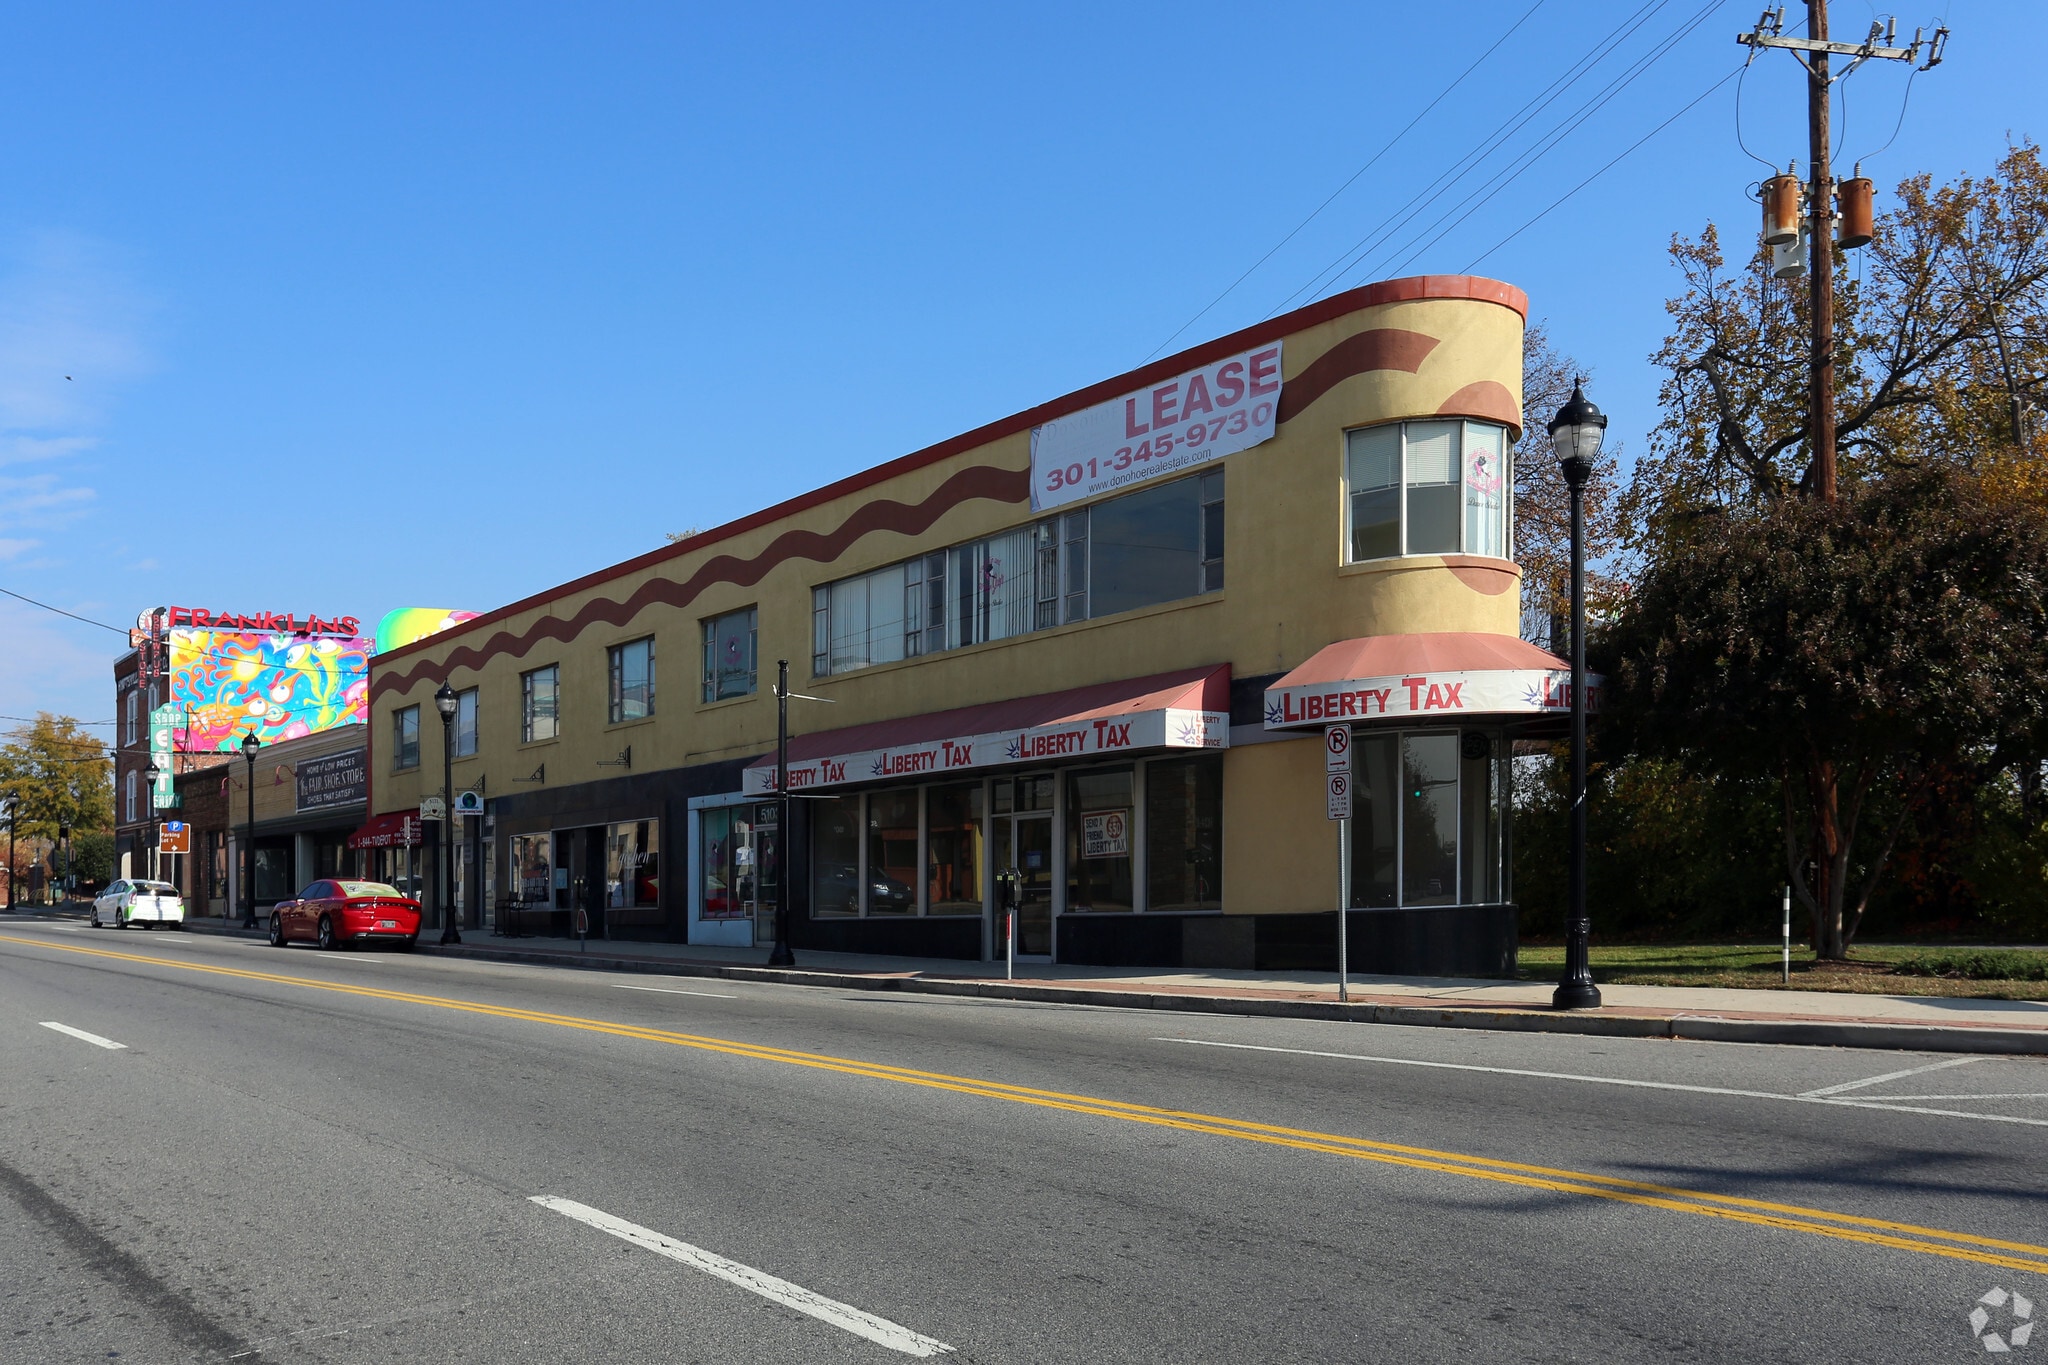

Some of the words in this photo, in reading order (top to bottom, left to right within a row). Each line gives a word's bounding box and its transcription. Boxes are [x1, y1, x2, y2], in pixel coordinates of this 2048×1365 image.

[1126, 347, 1279, 440] LEASE
[1046, 402, 1273, 492] 301-345-9730
[1088, 448, 1212, 493] www.donohoerealestate.com
[168, 605, 361, 636] FRANKLINS
[152, 614, 160, 678] BREWPUB
[139, 642, 147, 689] STORE
[1283, 688, 1392, 723] LIBERTY
[1402, 677, 1464, 711] TAX
[155, 712, 181, 726] SHOP
[1195, 712, 1221, 724] LIBERTY
[1195, 724, 1209, 735] TAX
[1020, 730, 1088, 758] LIBERTY
[1093, 720, 1131, 749] TAX
[1195, 735, 1221, 747] SERVICE
[154, 728, 170, 792] EAT
[306, 765, 320, 775] HOME
[324, 761, 336, 771] LOW
[336, 757, 355, 769] PRICES
[882, 750, 938, 775] LIBERTY
[942, 741, 972, 768] TAX
[771, 767, 817, 790] LBERTY
[820, 759, 846, 783] TAX
[153, 795, 181, 808] ENJOY
[306, 794, 323, 804] SHOES
[323, 791, 335, 801] THAT
[335, 787, 355, 799] SATISFY
[1085, 817, 1099, 828] SEND
[1099, 816, 1103, 827] A
[1086, 830, 1104, 841] FRIEND
[1086, 840, 1112, 854] LIBERTY
[1112, 838, 1126, 851] TAX
